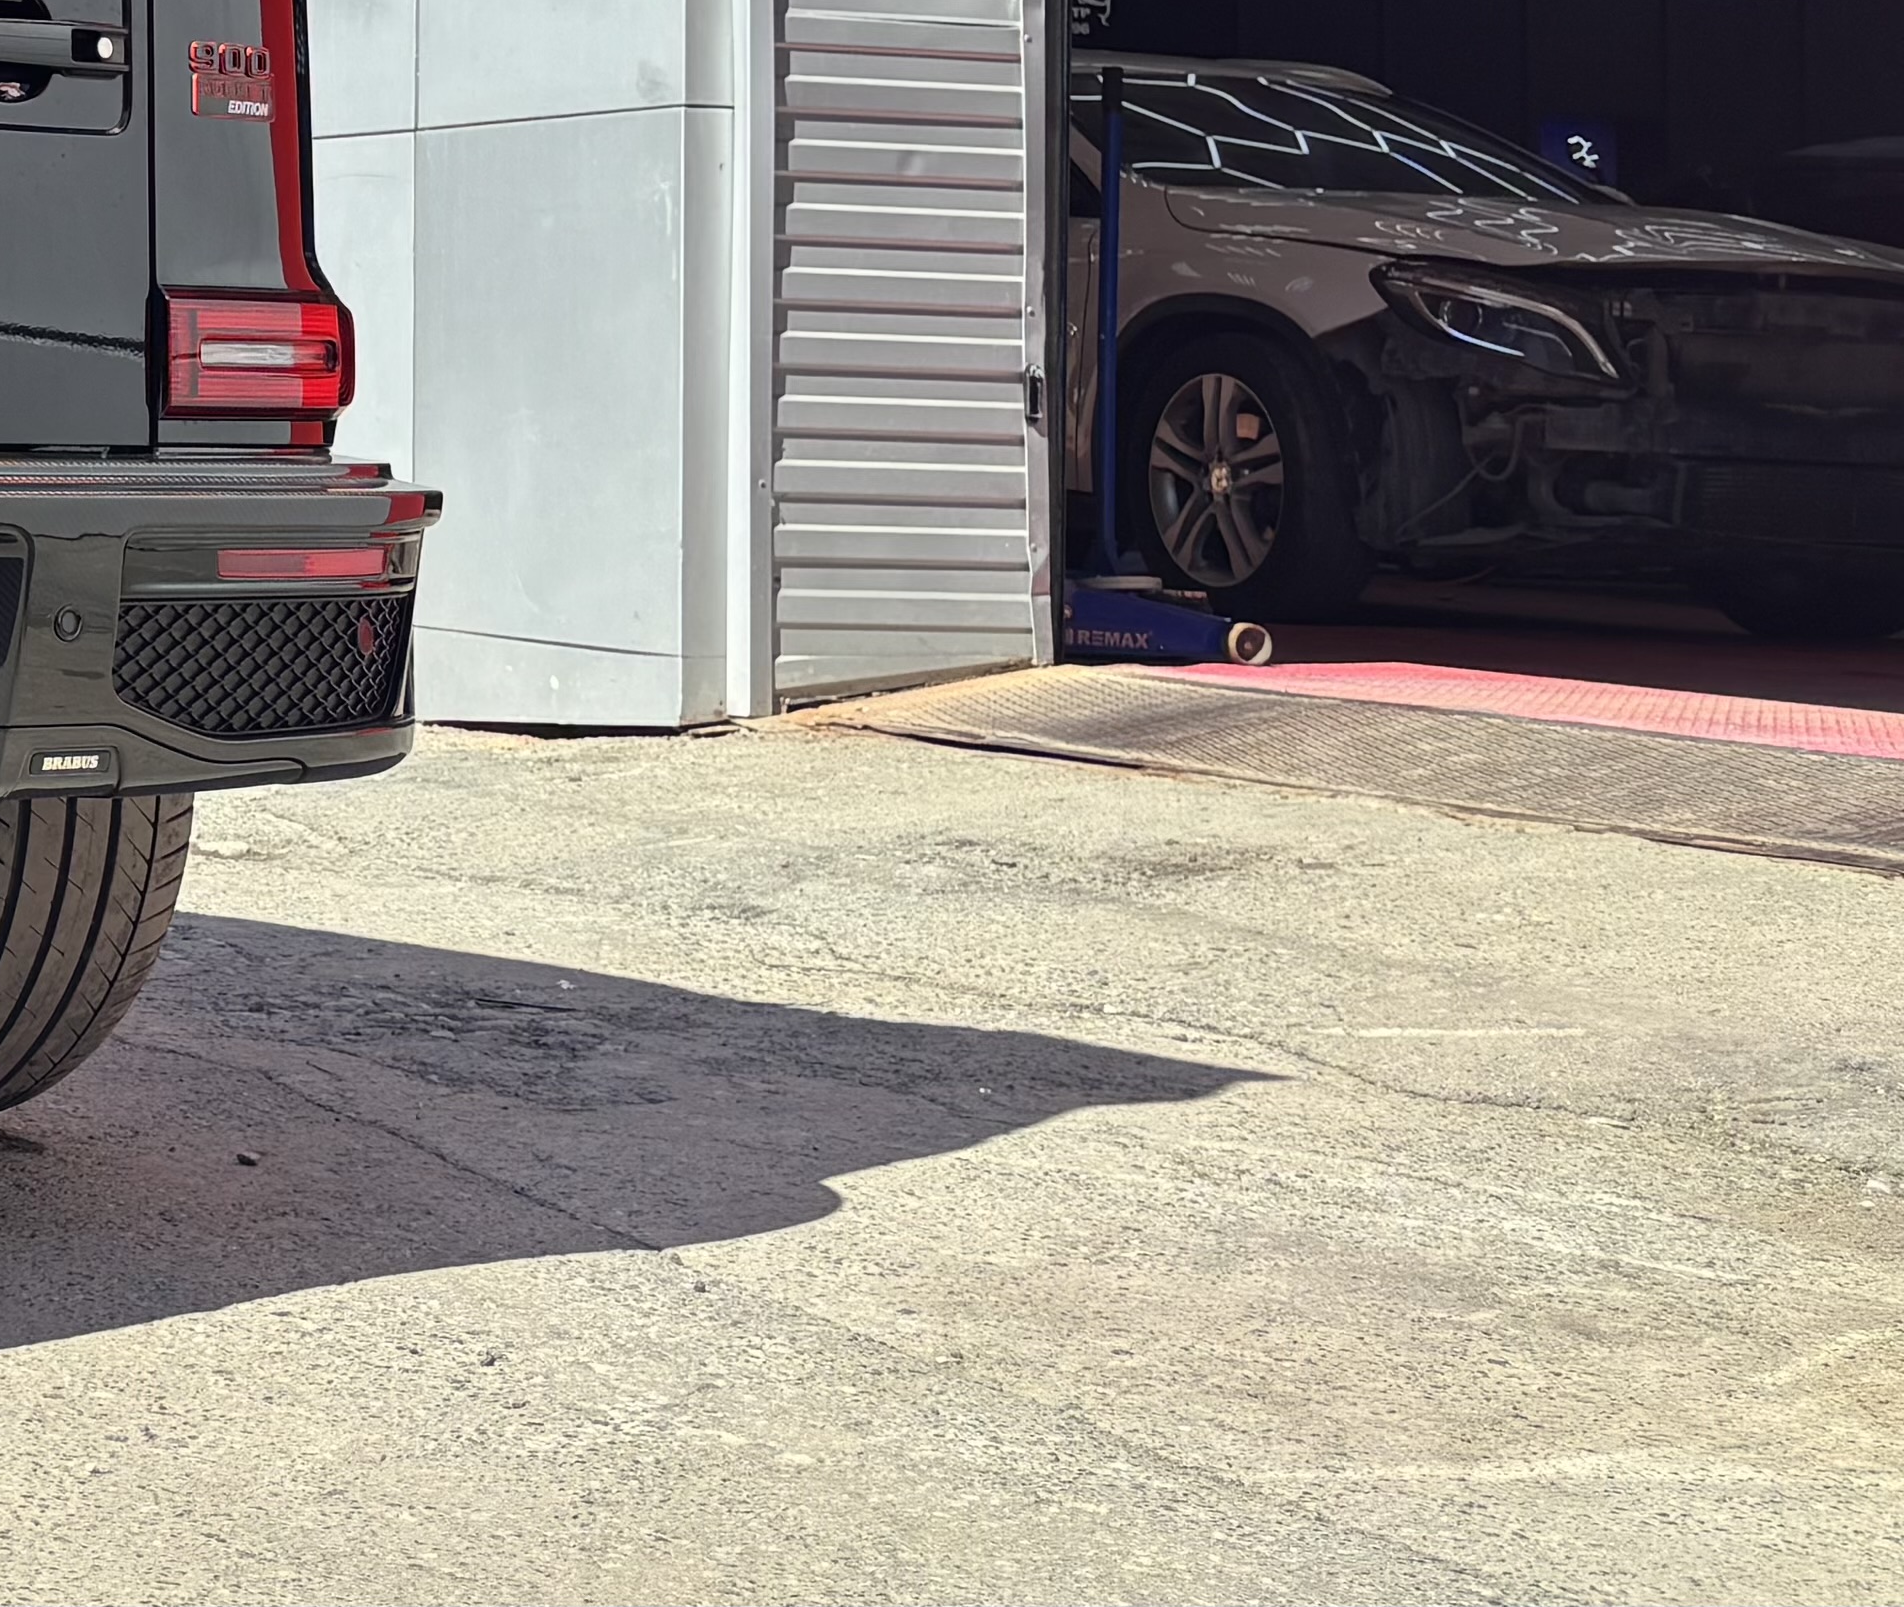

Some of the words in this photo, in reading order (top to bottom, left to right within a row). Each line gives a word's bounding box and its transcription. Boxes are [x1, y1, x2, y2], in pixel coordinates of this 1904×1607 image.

[188, 41, 271, 80] 900
[227, 100, 269, 116] EDITION
[1077, 629, 1149, 649] REMAX
[41, 755, 99, 771] BRABUS
